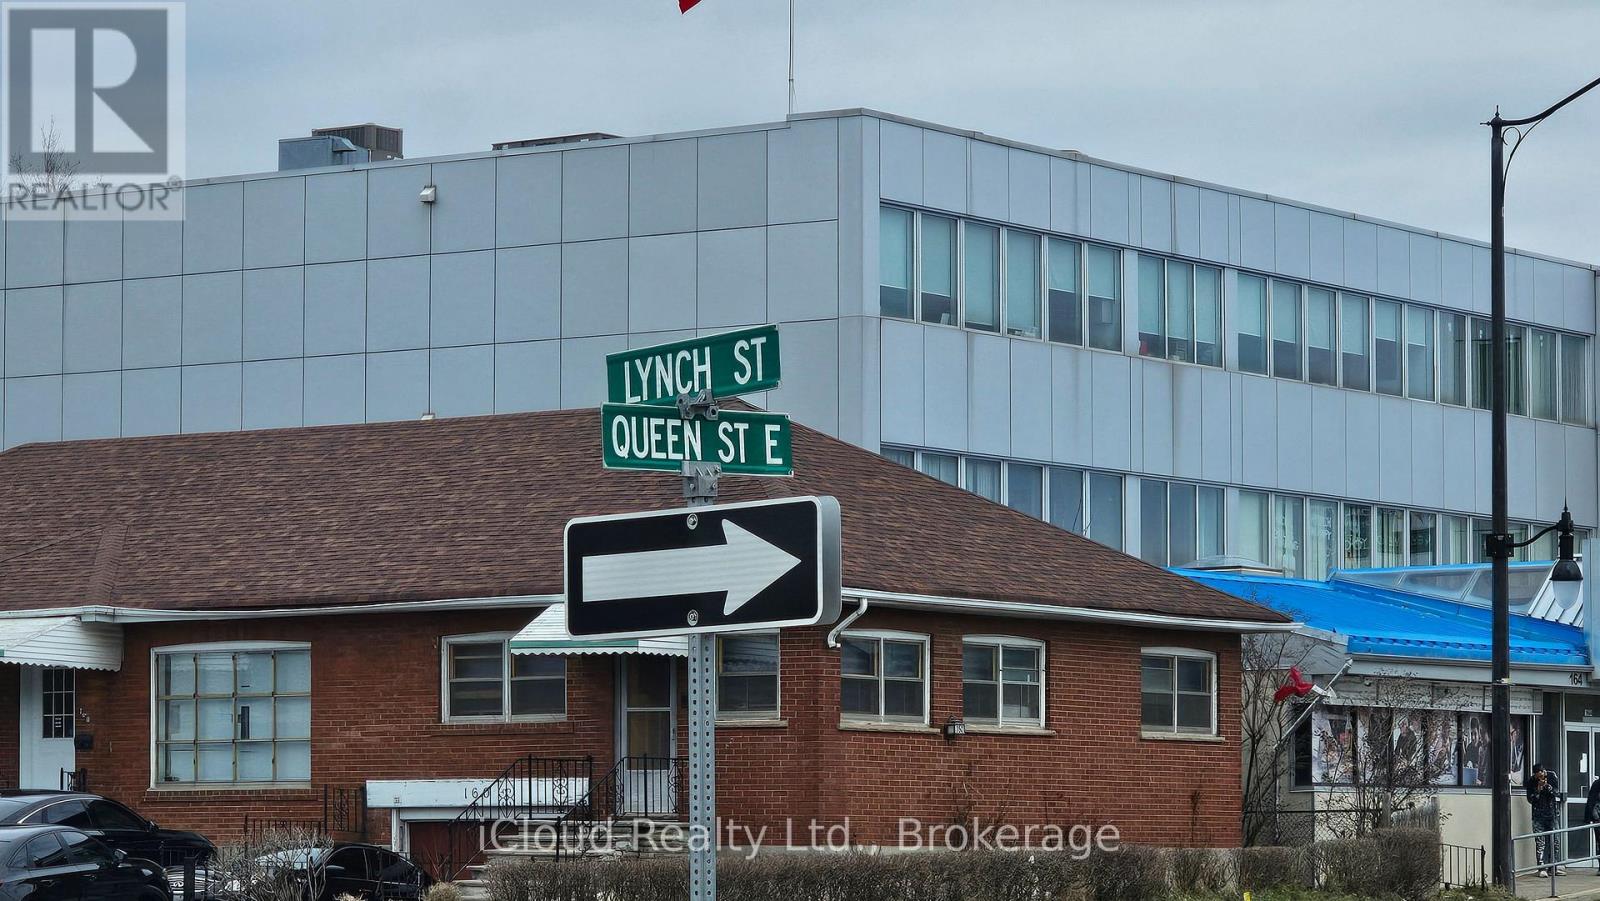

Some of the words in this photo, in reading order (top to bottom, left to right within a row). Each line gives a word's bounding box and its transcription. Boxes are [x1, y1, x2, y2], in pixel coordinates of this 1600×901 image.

[624, 346, 712, 404] LYNCH
[734, 336, 767, 385] ST
[611, 415, 702, 461] QUEEN
[718, 421, 749, 464] ST
[765, 424, 783, 465] E
[1569, 672, 1583, 686] 164
